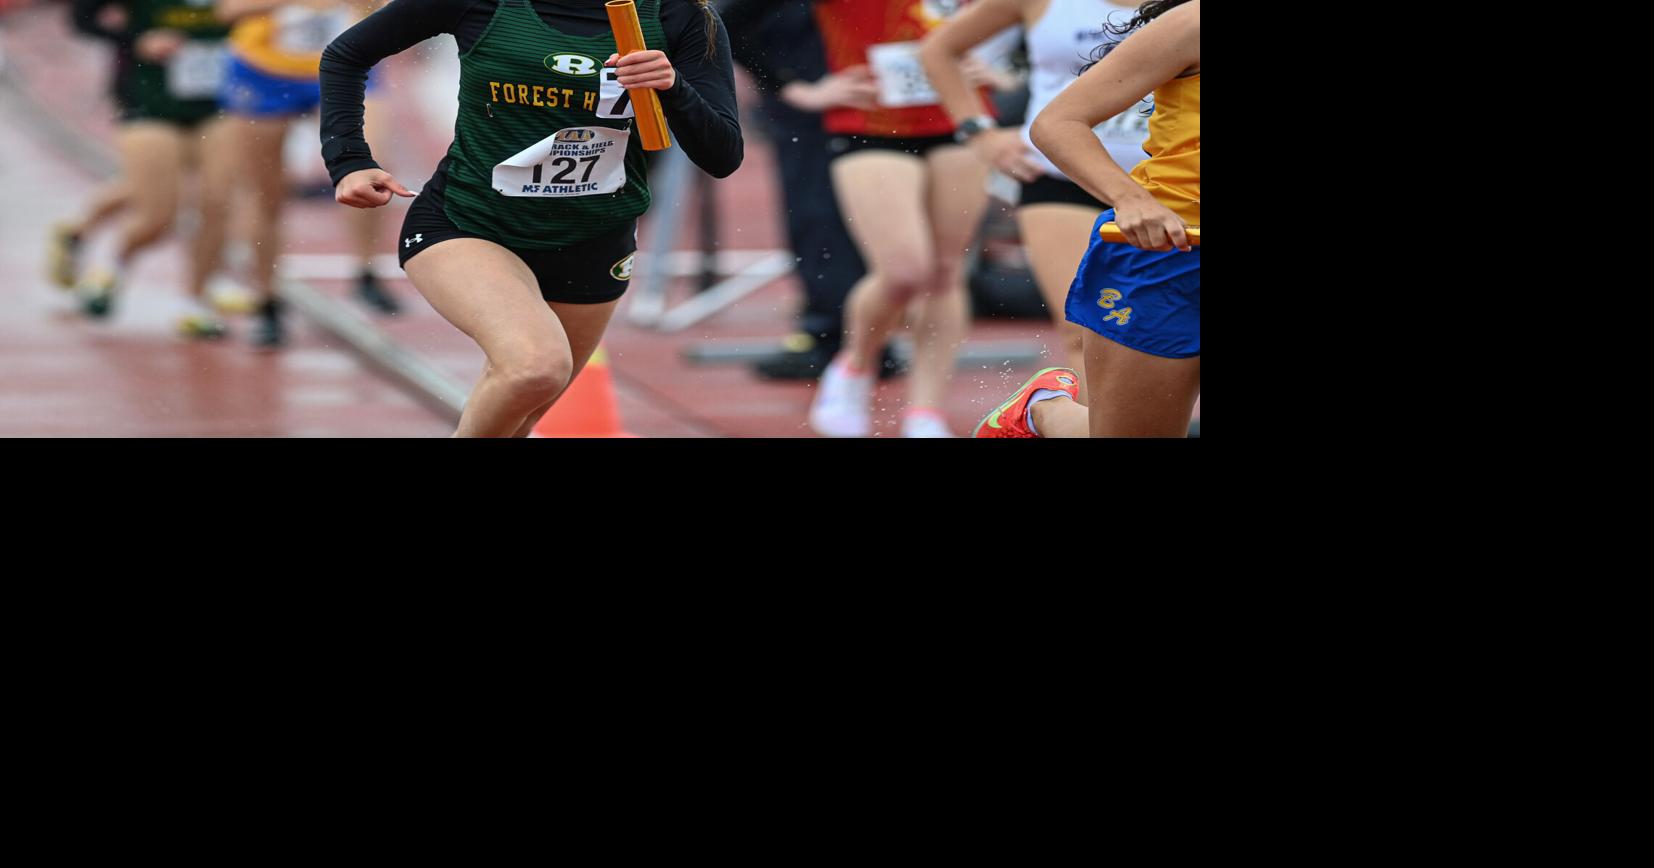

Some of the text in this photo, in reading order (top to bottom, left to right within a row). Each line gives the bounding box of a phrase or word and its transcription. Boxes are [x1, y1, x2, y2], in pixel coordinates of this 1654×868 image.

[551, 54, 598, 75] R
[489, 81, 596, 111] FOREST H
[549, 147, 606, 157] PIONSHIPS
[551, 143, 580, 151] RACK
[532, 154, 601, 184] 127
[542, 182, 598, 193] ATHLETIC
